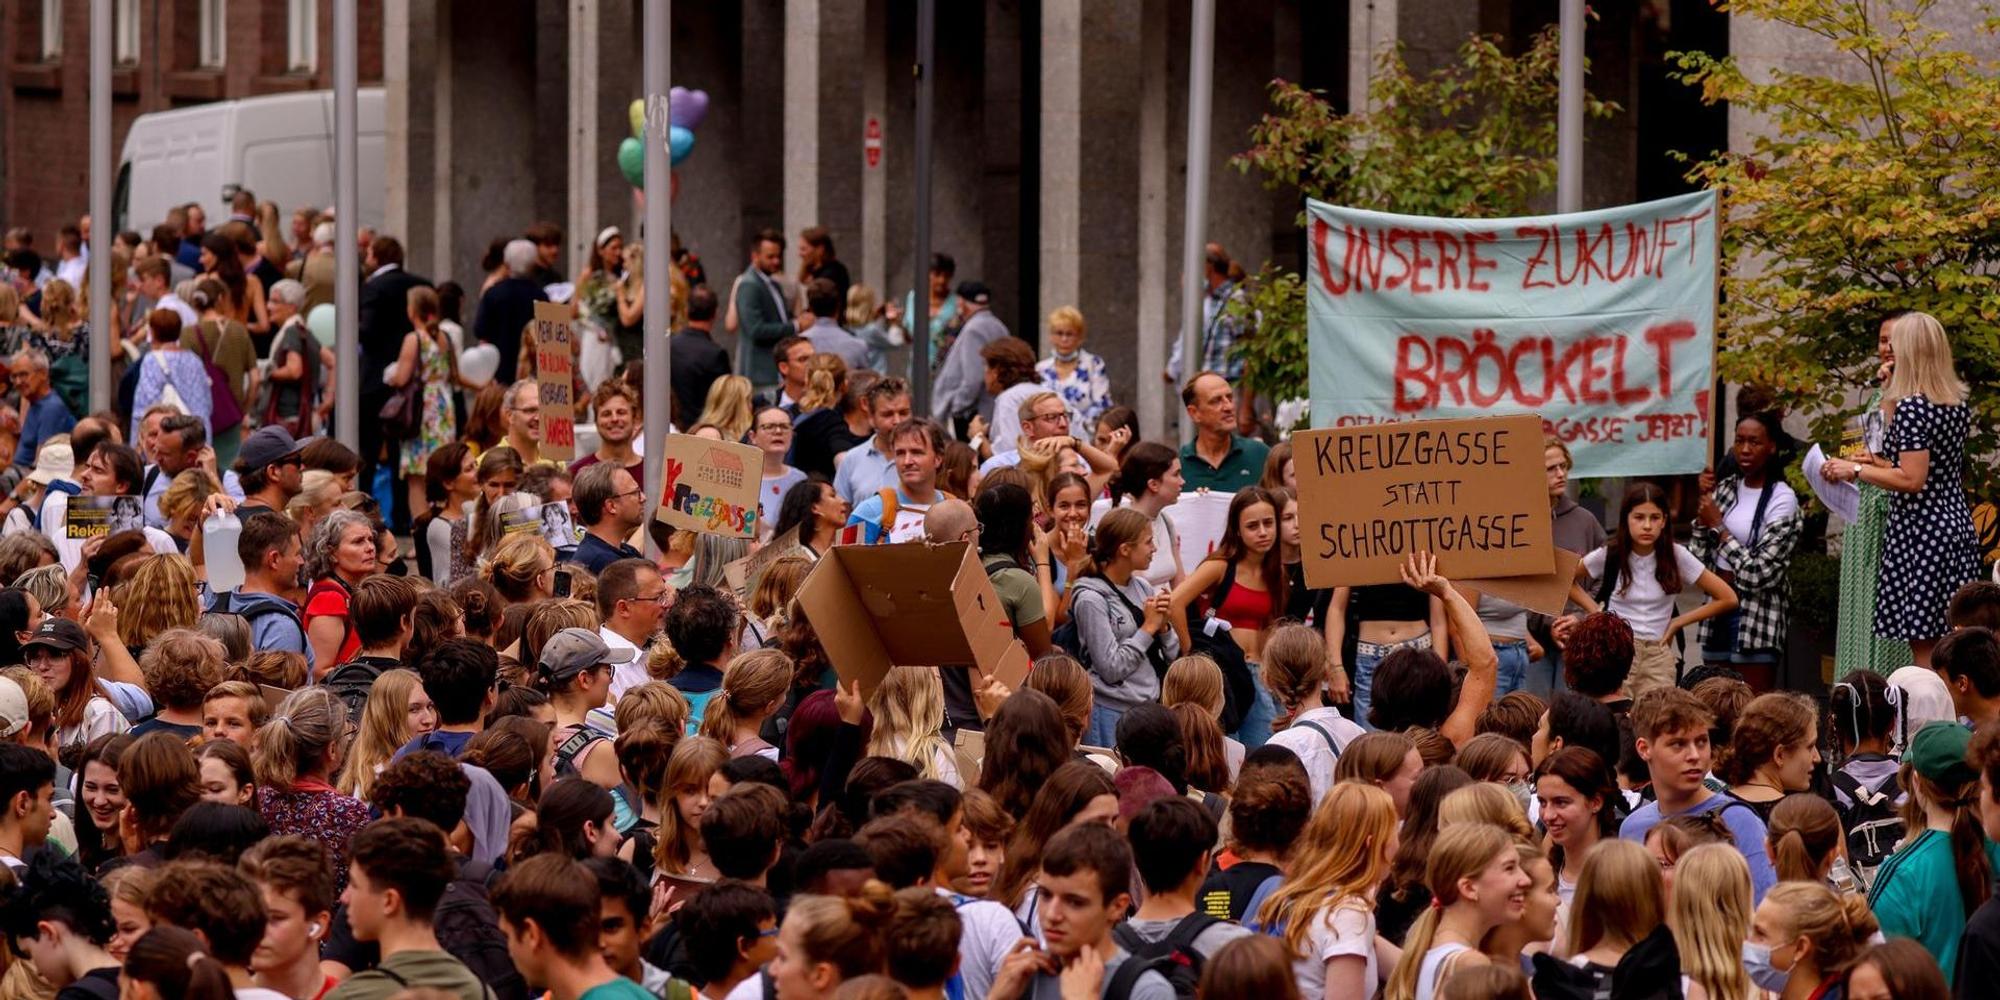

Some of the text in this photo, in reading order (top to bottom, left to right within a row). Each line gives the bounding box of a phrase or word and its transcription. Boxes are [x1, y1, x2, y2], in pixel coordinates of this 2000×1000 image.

[1313, 208, 1712, 296] UNSERE ZUKUNFT
[1392, 321, 1697, 413] BRÖCKELT
[1634, 391, 1709, 443] JETZT!
[1314, 430, 1511, 476] KREUZGASSE
[662, 458, 756, 534] Kreuzgasse
[1383, 480, 1462, 507] STATT
[68, 524, 111, 537] Reker
[1319, 514, 1532, 559] SCHROTTGASSE
